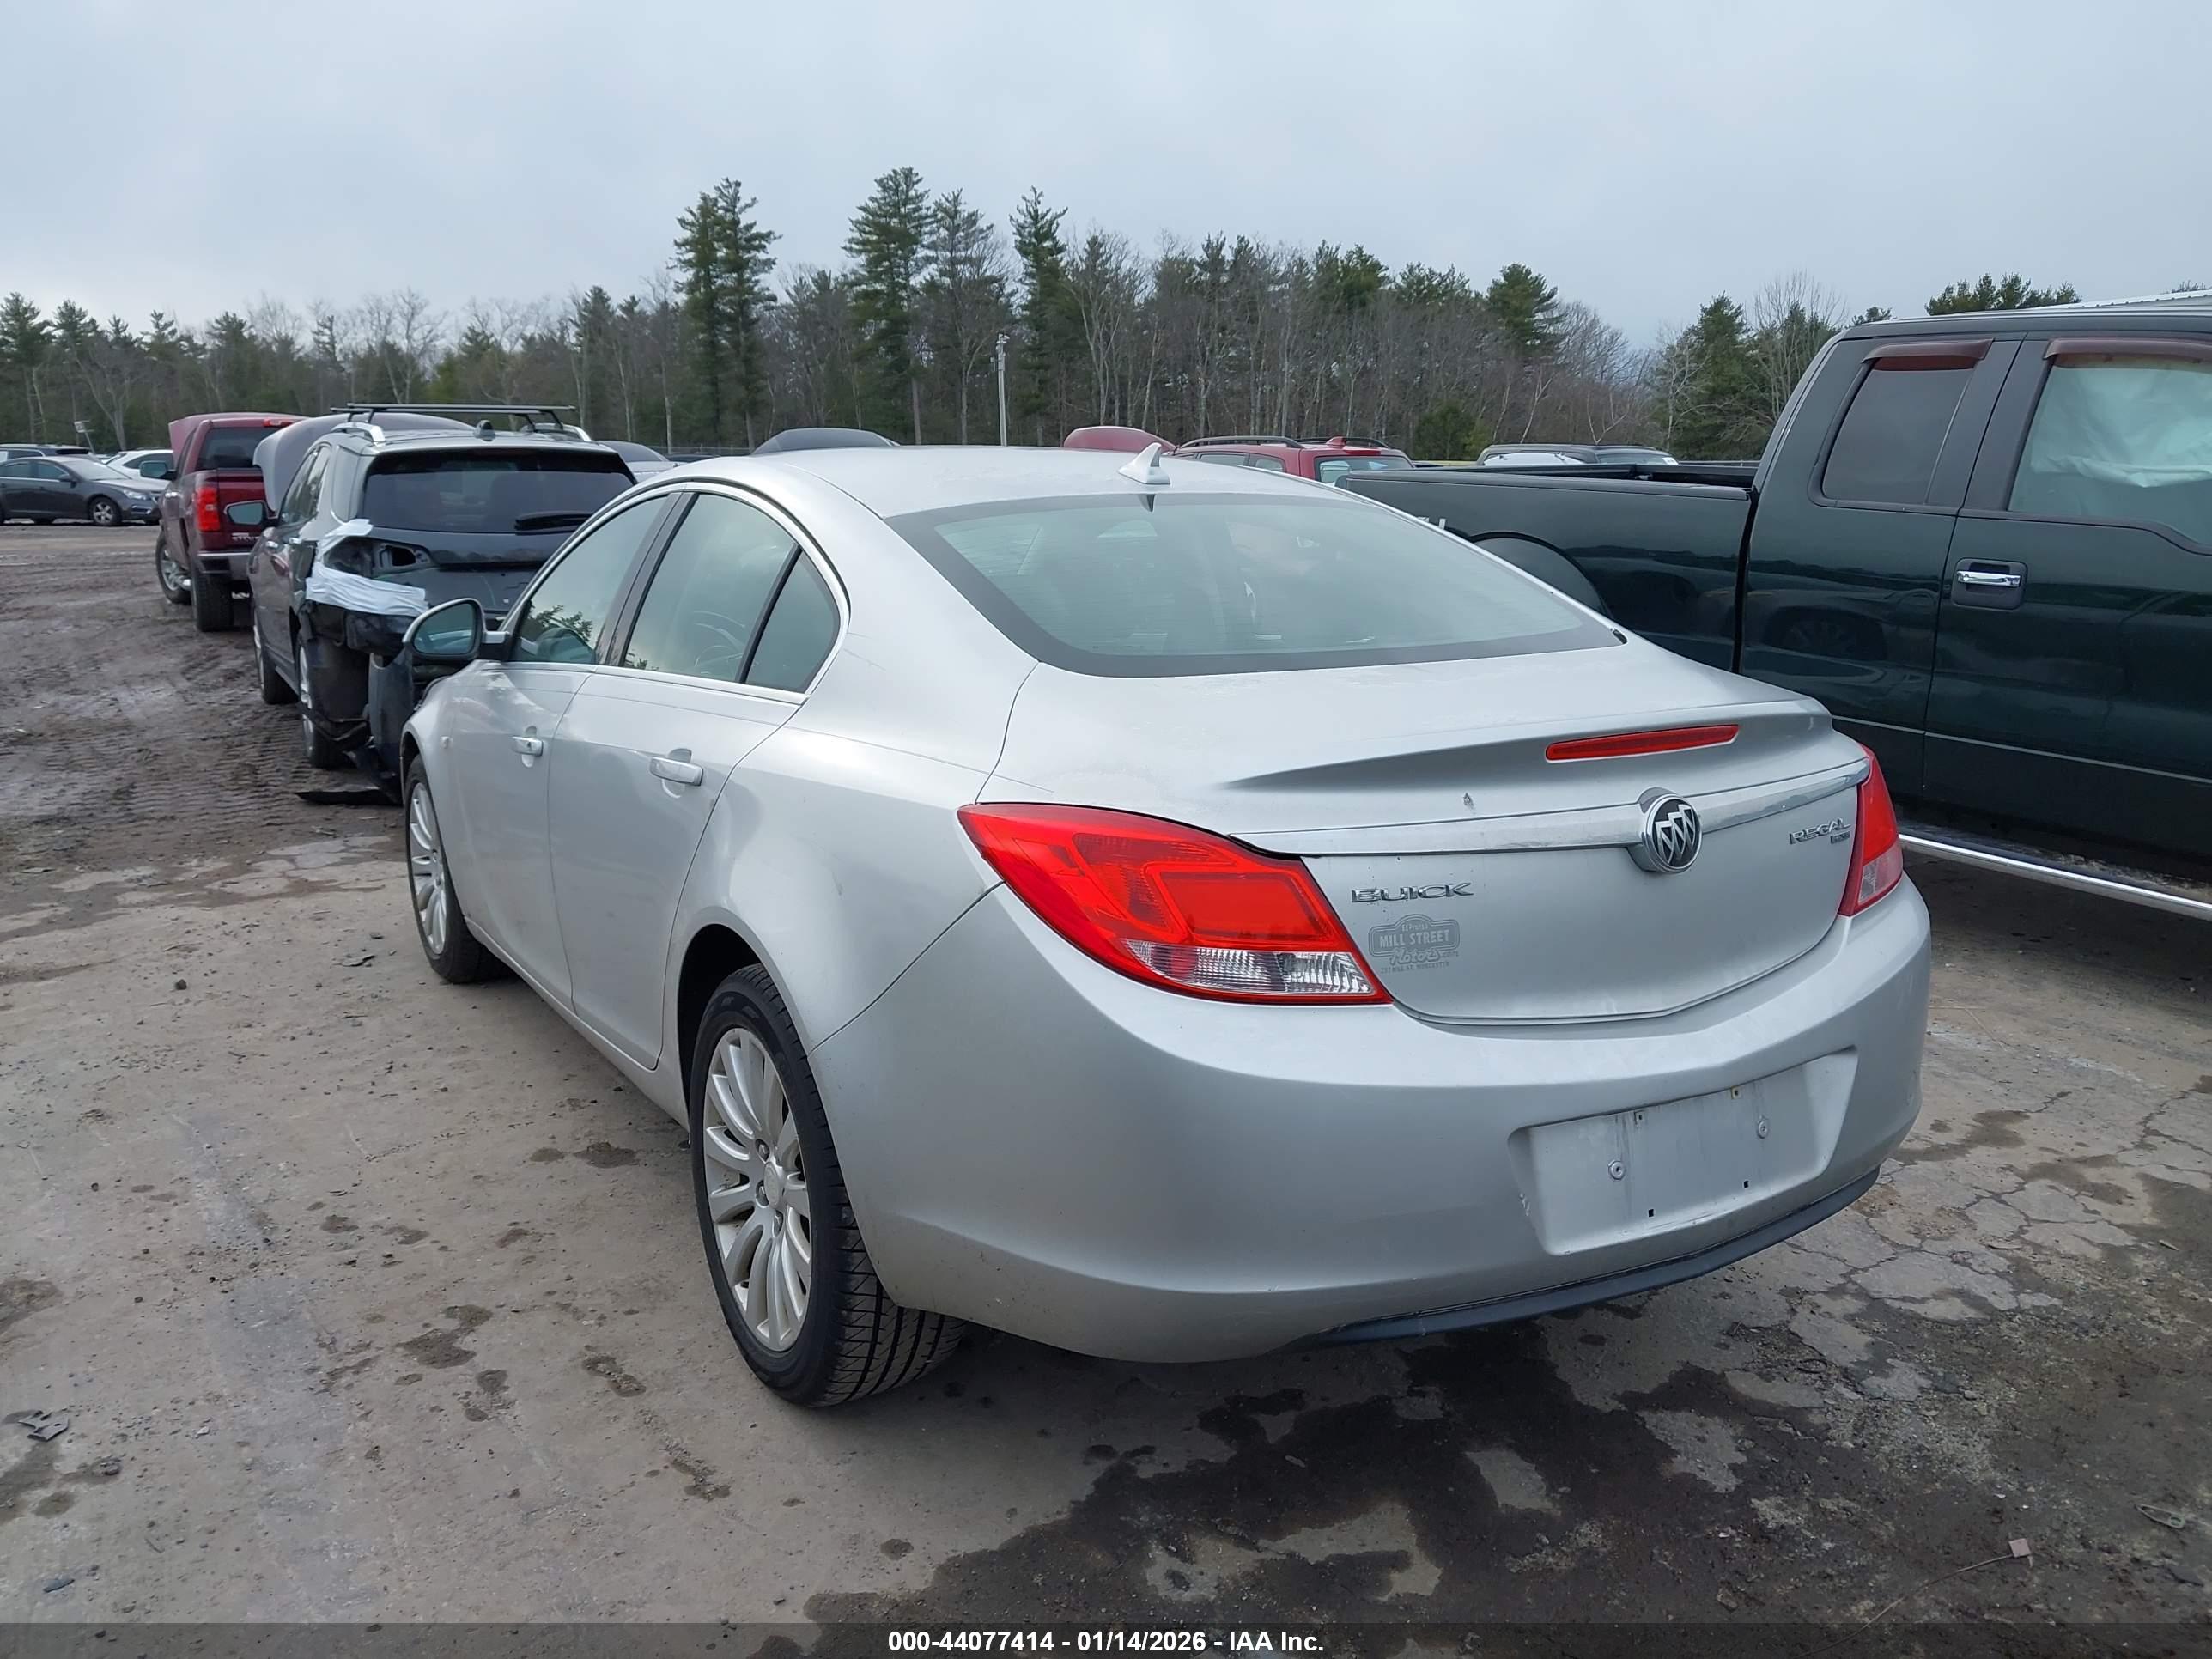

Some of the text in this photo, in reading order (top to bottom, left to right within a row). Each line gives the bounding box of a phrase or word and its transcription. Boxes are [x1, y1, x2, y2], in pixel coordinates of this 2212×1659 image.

[1789, 817, 1852, 845] REGAL
[1351, 882, 1474, 903] BUICK
[1379, 929, 1450, 948] MILL STREET
